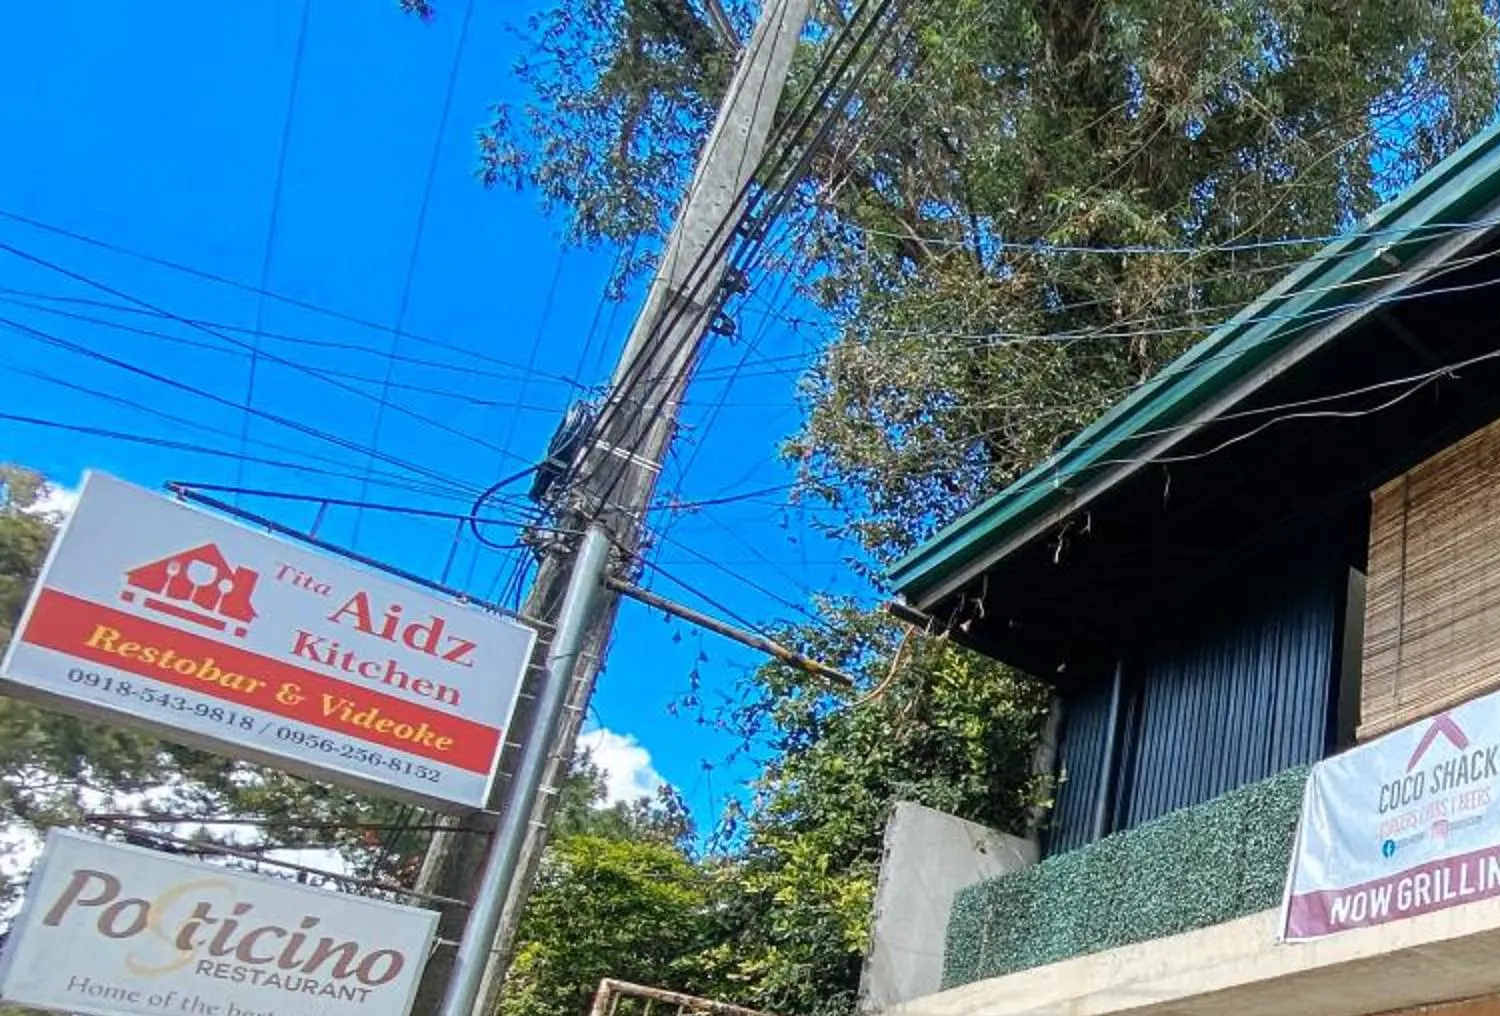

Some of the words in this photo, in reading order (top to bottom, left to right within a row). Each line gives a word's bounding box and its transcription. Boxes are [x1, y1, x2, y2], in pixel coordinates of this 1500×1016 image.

[272, 561, 335, 597] Tita
[327, 591, 478, 669] Aidz
[83, 623, 268, 696] Restobar
[276, 681, 306, 707] &
[320, 693, 457, 752] Videoke
[290, 629, 463, 707] Kitchen
[68, 667, 255, 731] 0918-543-9818
[276, 727, 441, 783] 0956-256-8152
[1378, 771, 1425, 814] COCO
[1430, 744, 1499, 795] SHACK
[1330, 884, 1395, 926] NOW
[67, 974, 143, 1005] Home
[147, 990, 176, 1010] of
[180, 995, 220, 1016] the
[195, 959, 373, 1004] RESTAURANT
